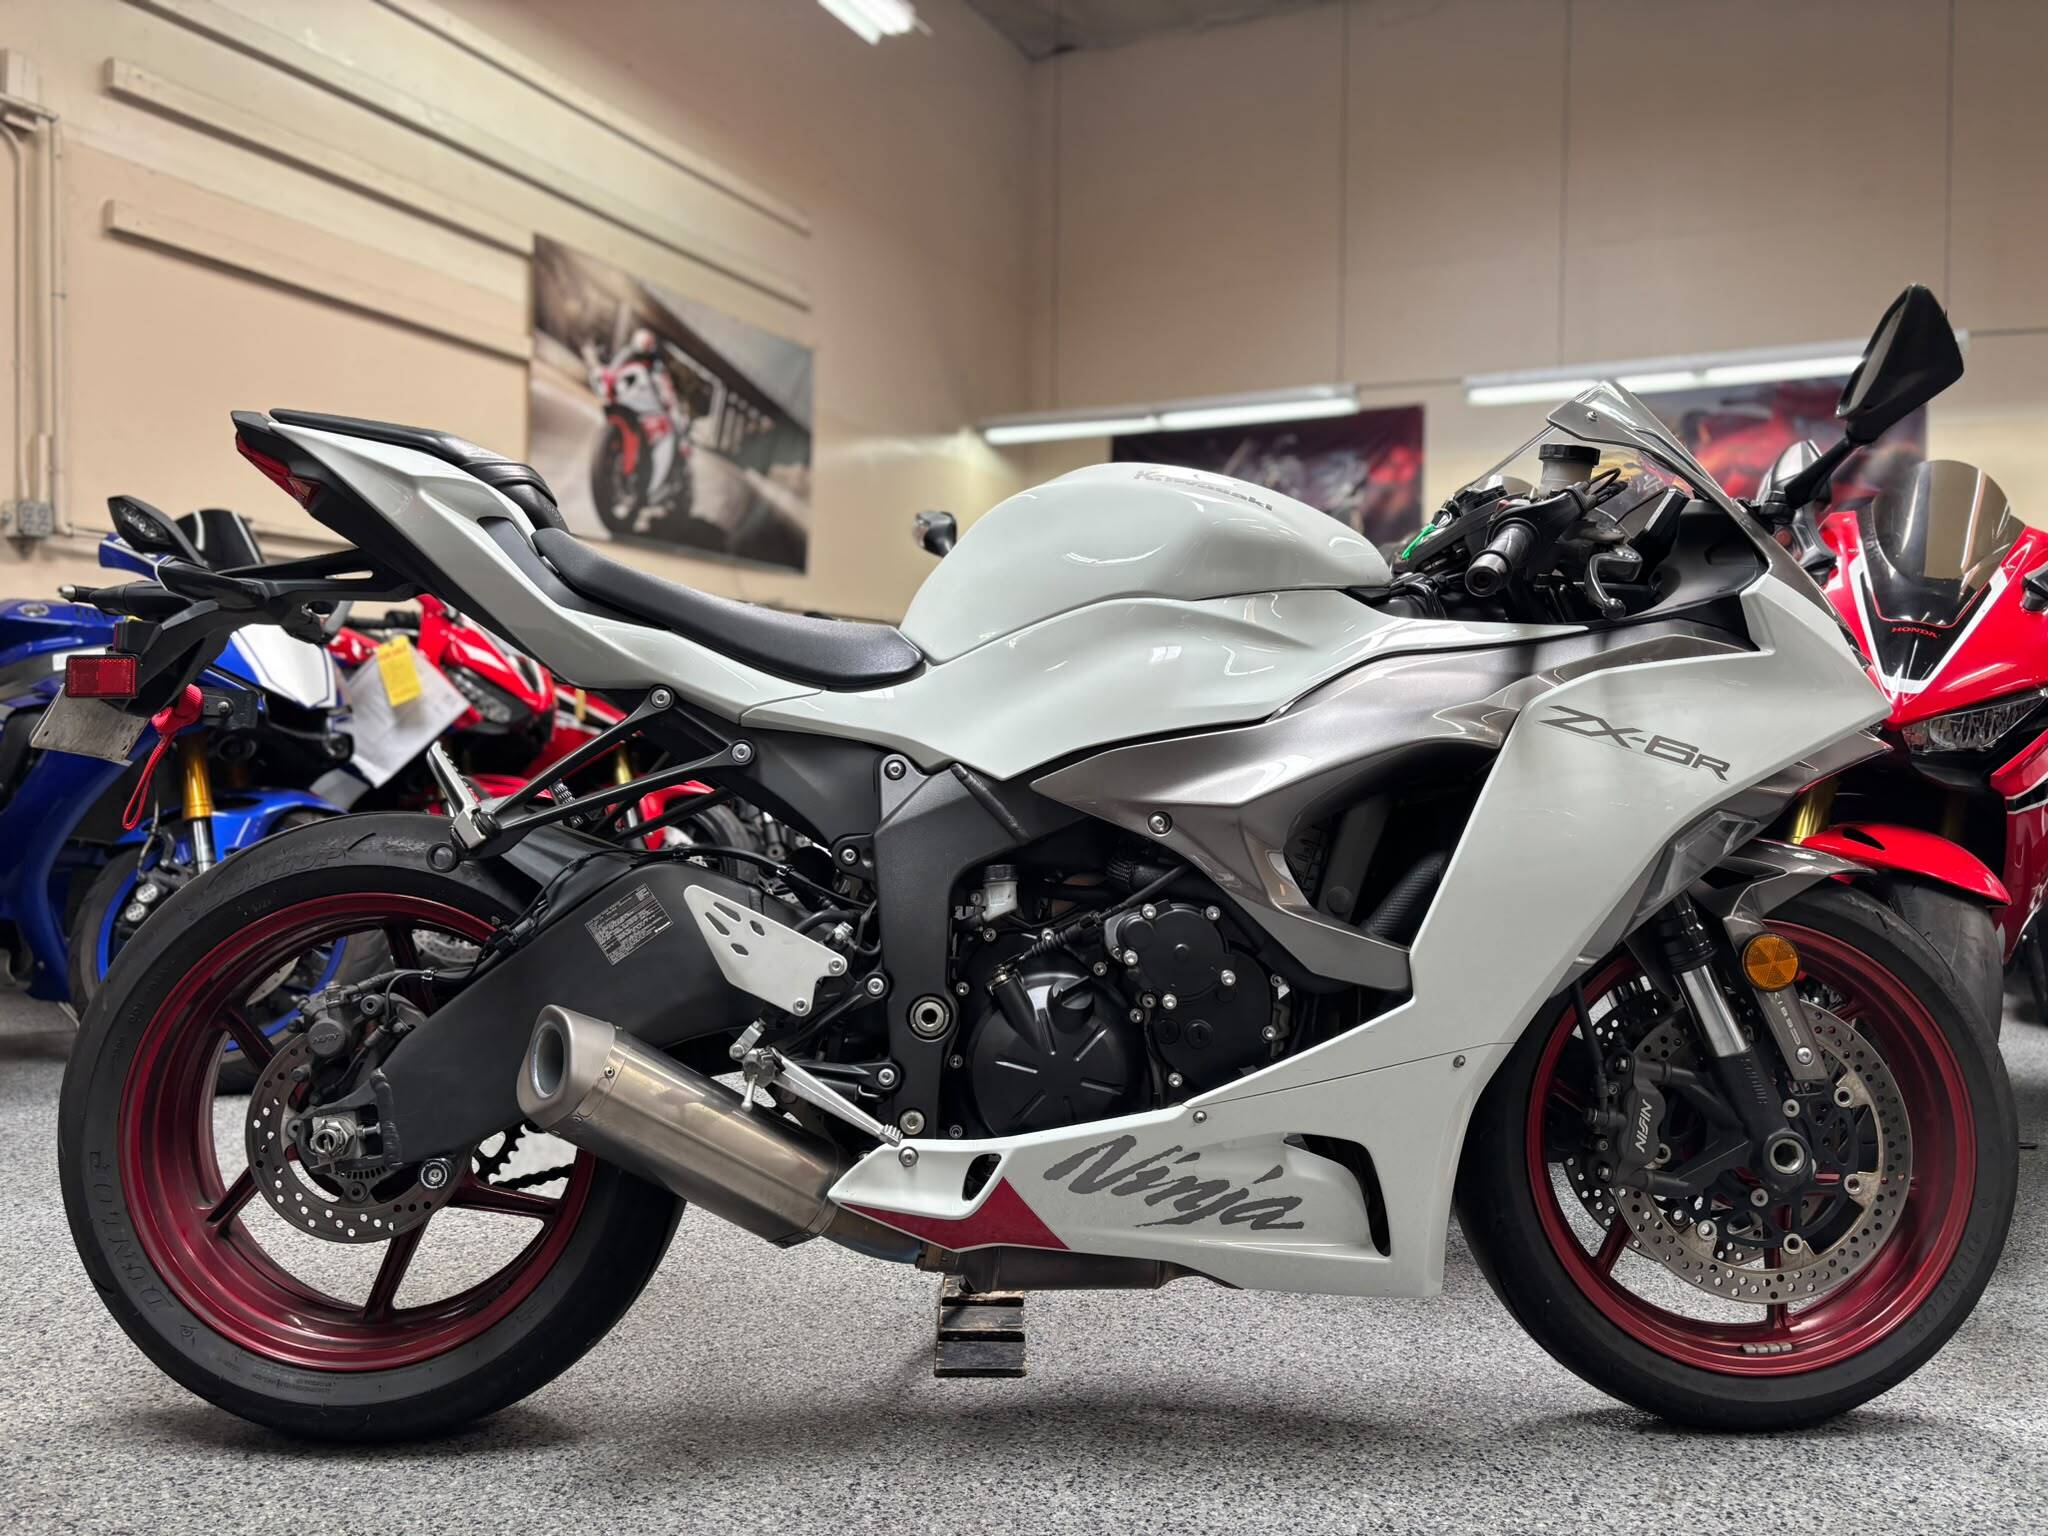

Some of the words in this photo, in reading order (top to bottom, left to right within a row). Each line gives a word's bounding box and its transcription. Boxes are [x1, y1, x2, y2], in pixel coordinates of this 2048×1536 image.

[1134, 470, 1273, 511] Kawasaki
[1891, 626, 1938, 639] HONDA
[1537, 705, 1730, 782] ZX-6R
[1634, 1098, 1653, 1153] NISSIN
[1043, 1134, 1305, 1231] Ninja
